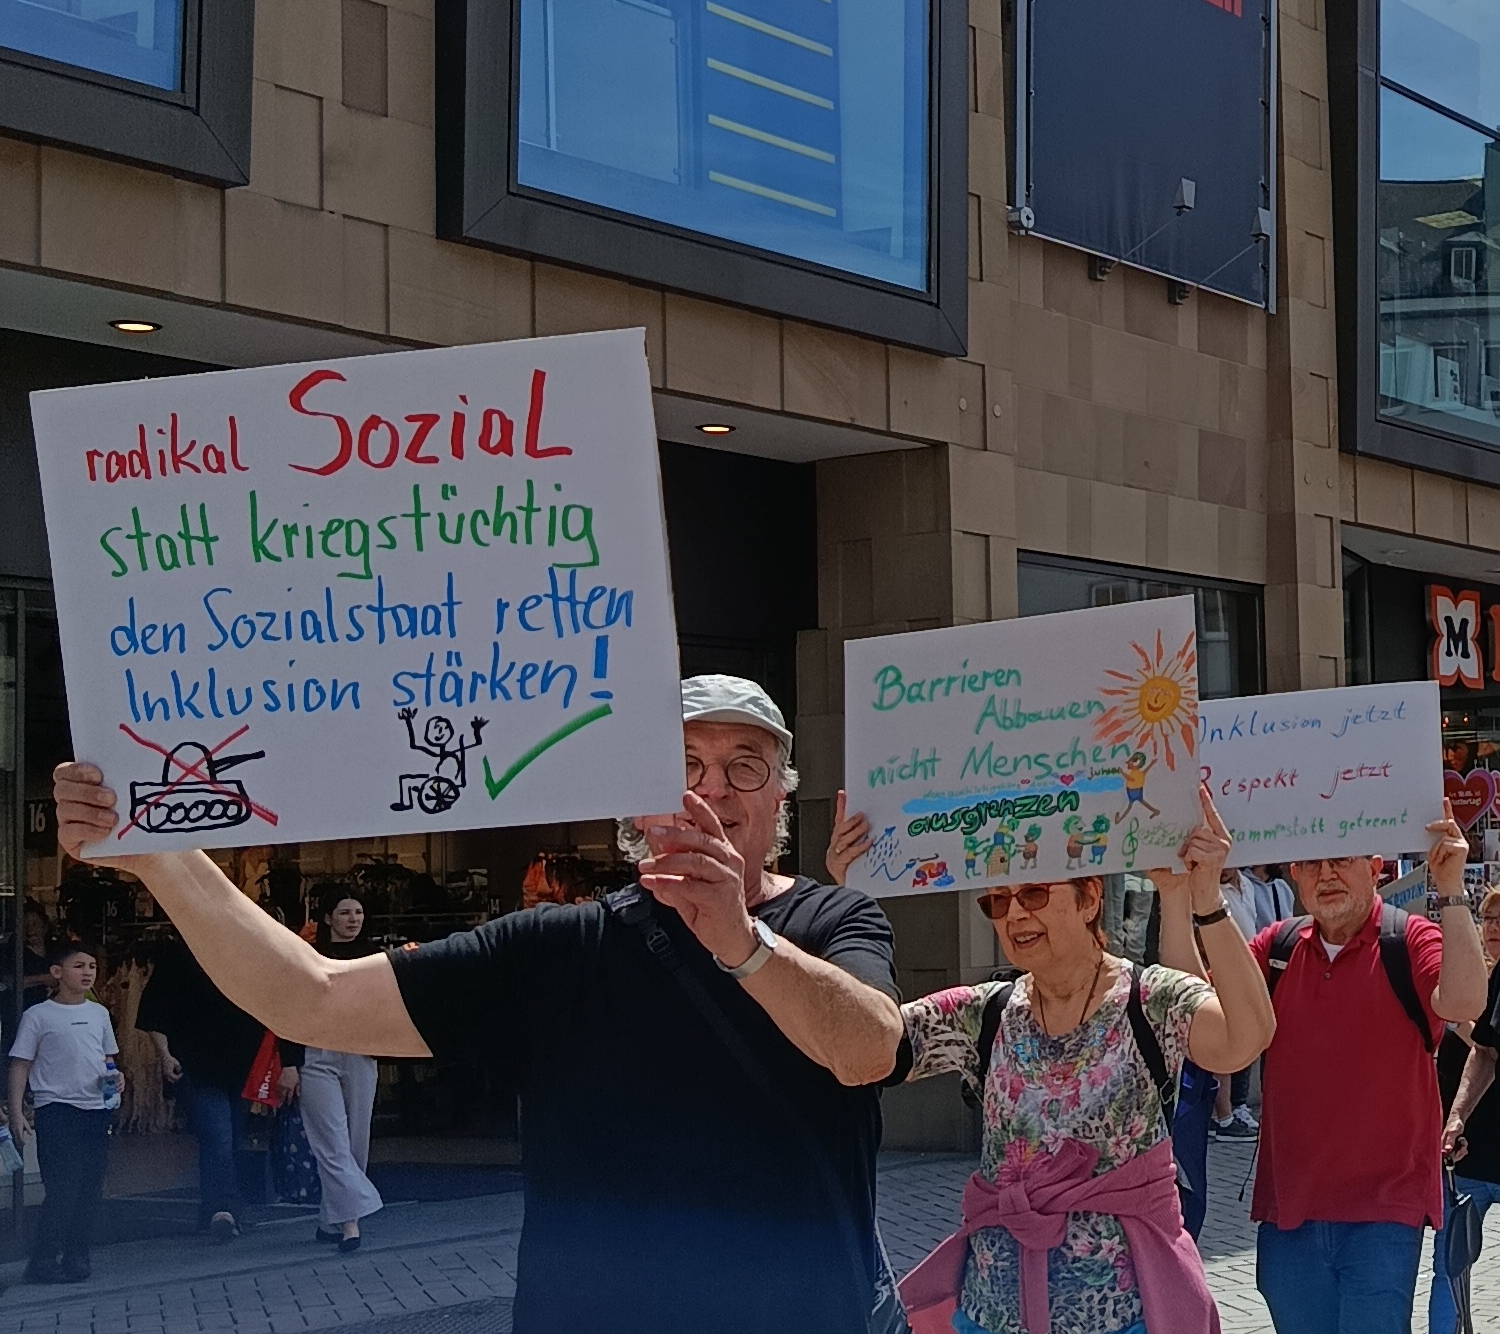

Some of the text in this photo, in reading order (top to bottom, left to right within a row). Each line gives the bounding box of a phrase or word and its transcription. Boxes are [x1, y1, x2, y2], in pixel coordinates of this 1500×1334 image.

[86, 413, 249, 483] radikal
[100, 479, 600, 580] statt kriegstüchtig
[111, 566, 634, 656] den Sozialstaat retten
[1444, 615, 1470, 659] M
[126, 659, 361, 724] Inklusion
[871, 659, 1021, 711] Barrieren
[975, 694, 1105, 734] Abbauen
[1330, 701, 1407, 738] jetzt
[868, 736, 1131, 788] nicht Menschen
[1200, 761, 1394, 802] Respekt jetzt
[907, 789, 1080, 837] ausgrenzen
[1338, 809, 1408, 838] getrennt
